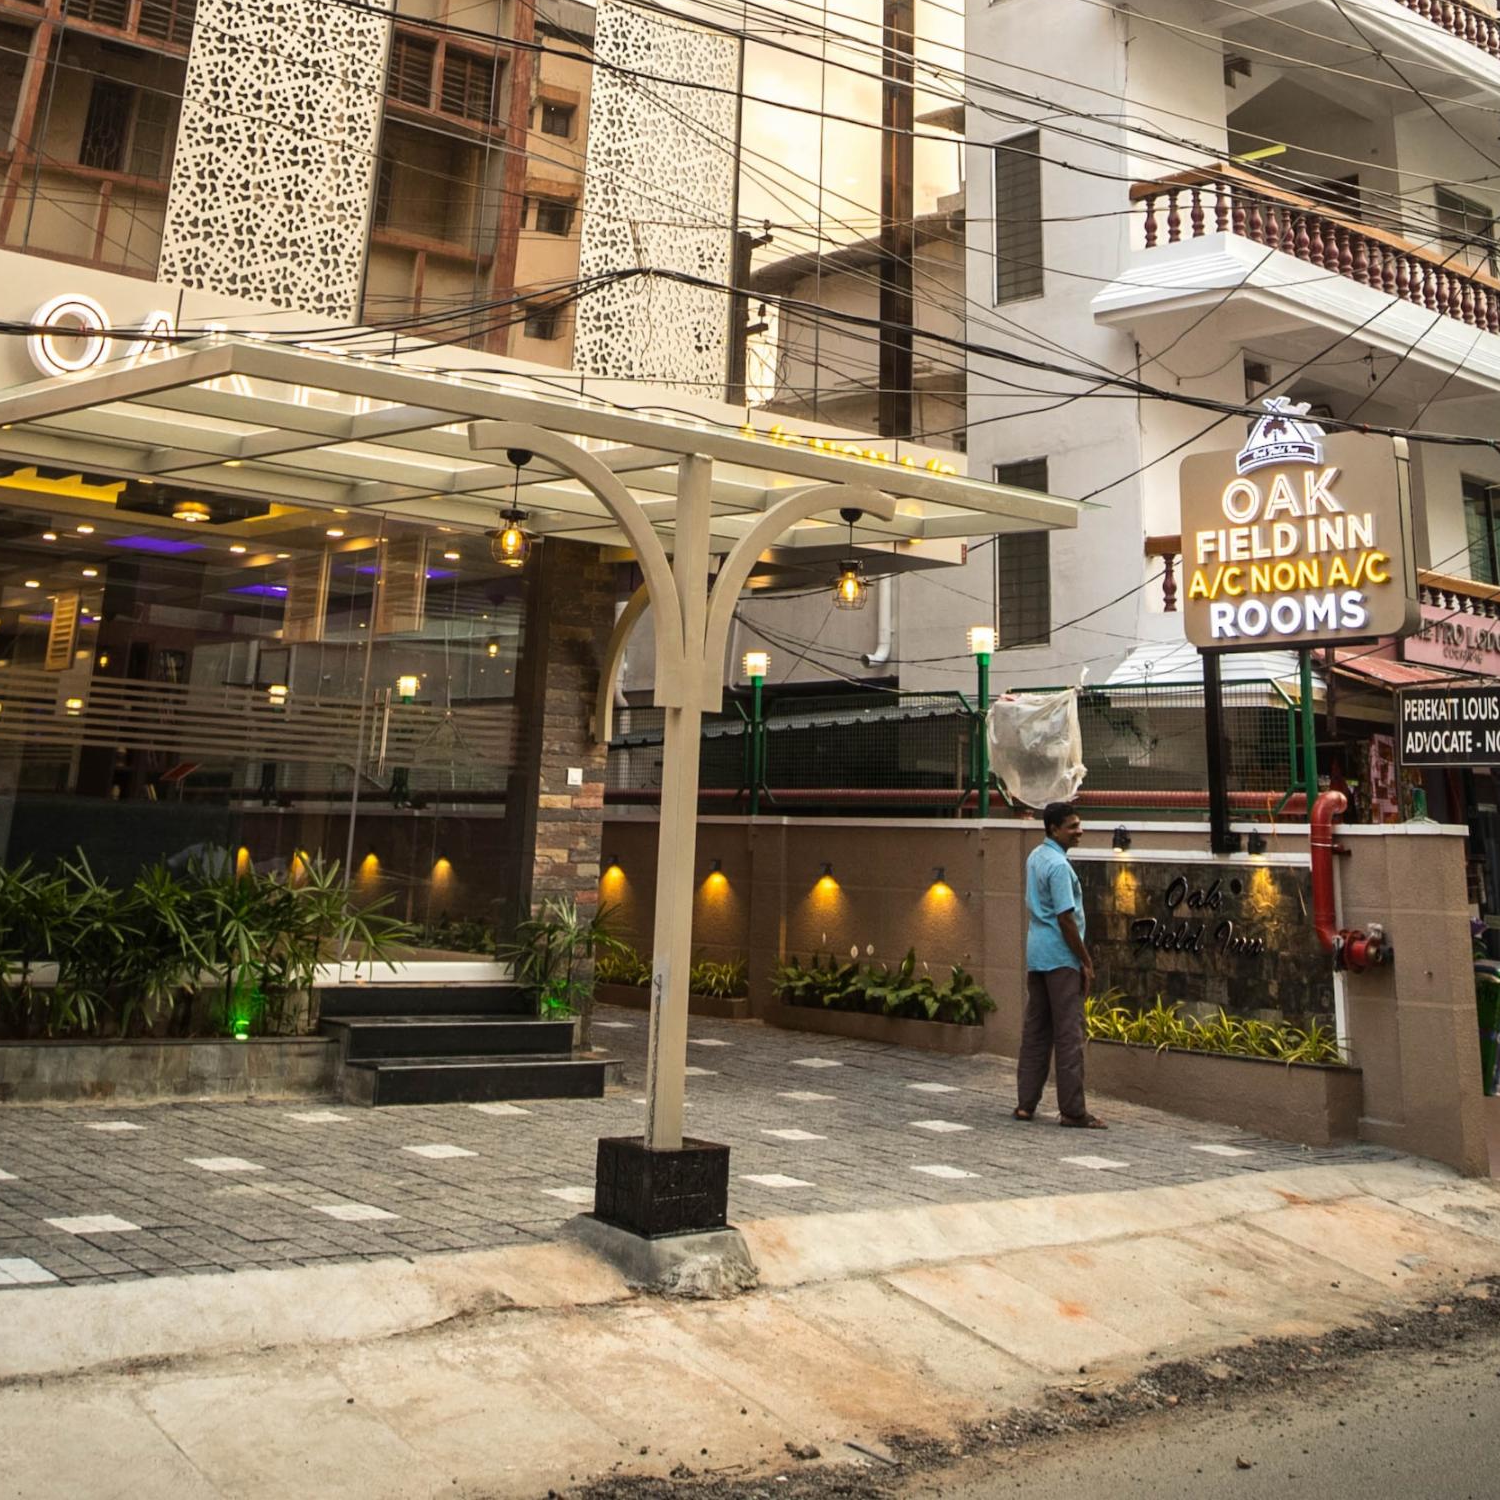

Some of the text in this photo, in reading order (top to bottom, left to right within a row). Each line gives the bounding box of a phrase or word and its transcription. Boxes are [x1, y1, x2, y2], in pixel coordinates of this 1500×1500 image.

[1221, 467, 1345, 525] OAK
[1195, 513, 1377, 565] FIELD INN
[1188, 550, 1391, 600] A/C NON A/C
[1209, 589, 1369, 639] ROOMS
[1404, 697, 1459, 722] PEREKATT
[1462, 696, 1499, 721] LOUIS
[1405, 730, 1472, 754] ADVOCATE
[1164, 875, 1224, 910] Oak
[1130, 917, 1265, 956] Field Inn
